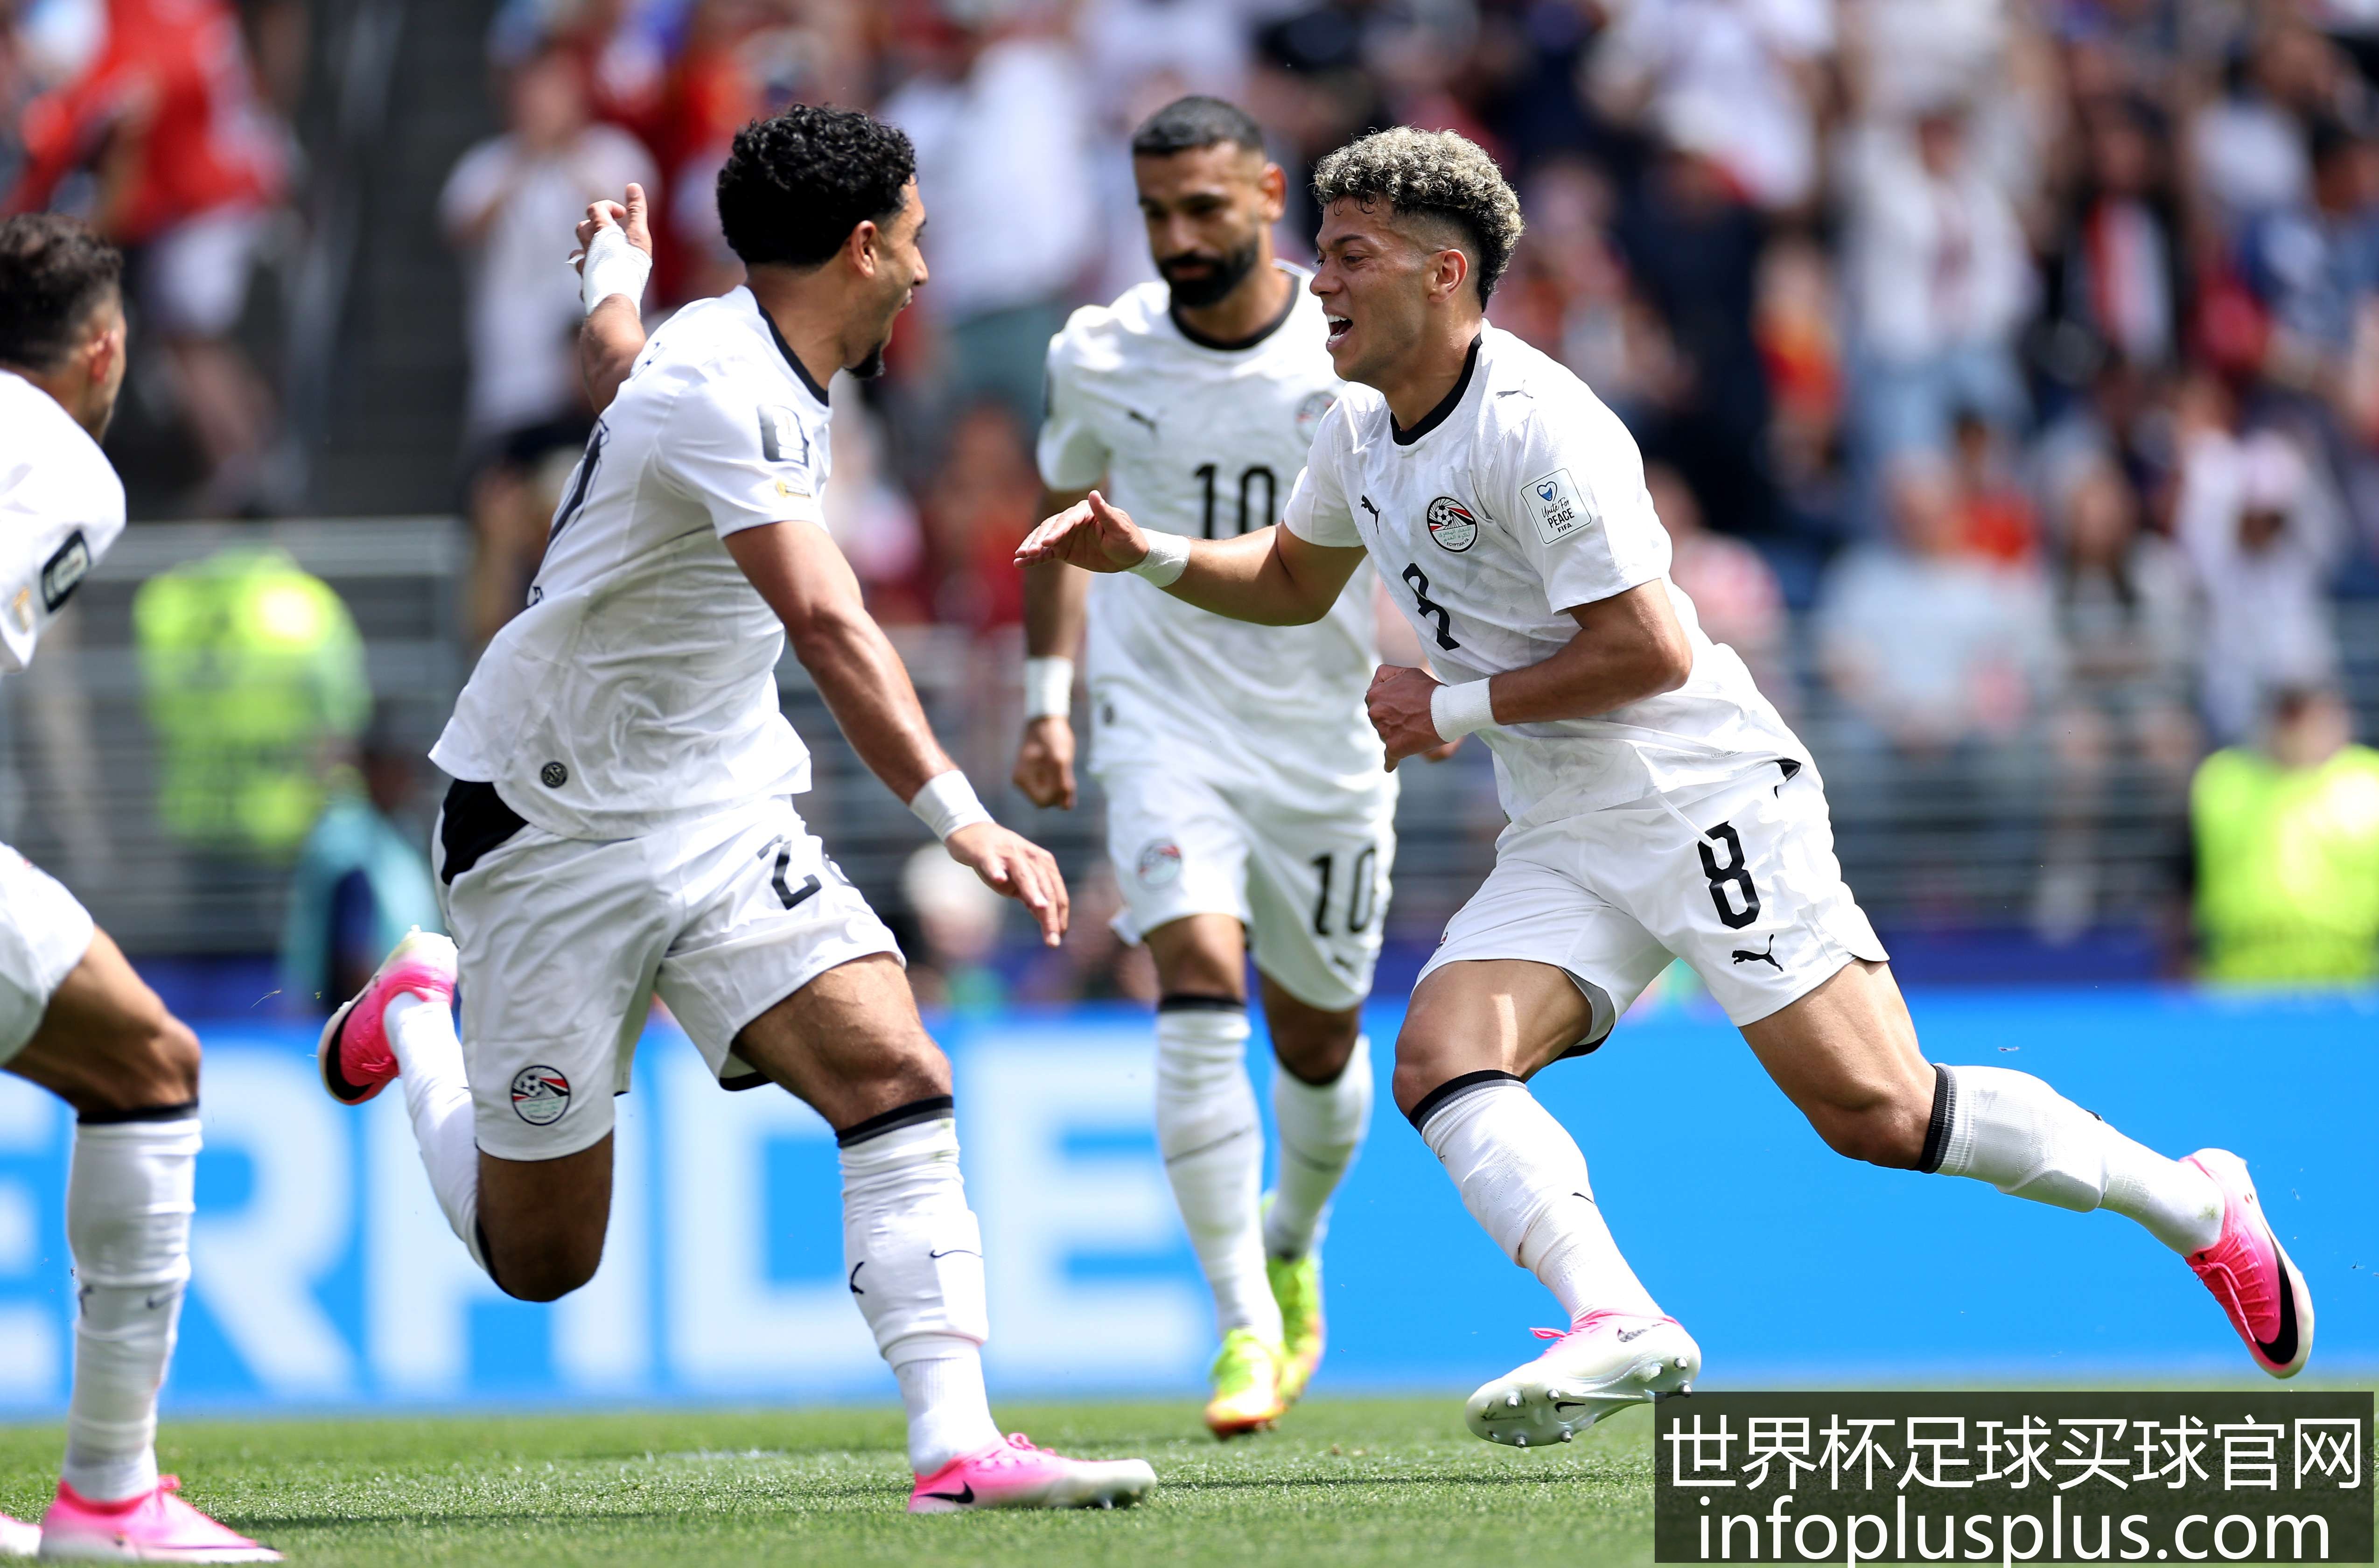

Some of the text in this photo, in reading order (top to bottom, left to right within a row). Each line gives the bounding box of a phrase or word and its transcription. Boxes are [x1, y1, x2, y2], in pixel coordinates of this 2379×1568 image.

[1195, 463, 1276, 539] 10
[1541, 497, 1569, 518] Unite For
[1547, 508, 1575, 528] PEACE
[1557, 522, 1572, 533] FIFA
[1311, 844, 1376, 937] 10
[1697, 820, 1761, 930] 8
